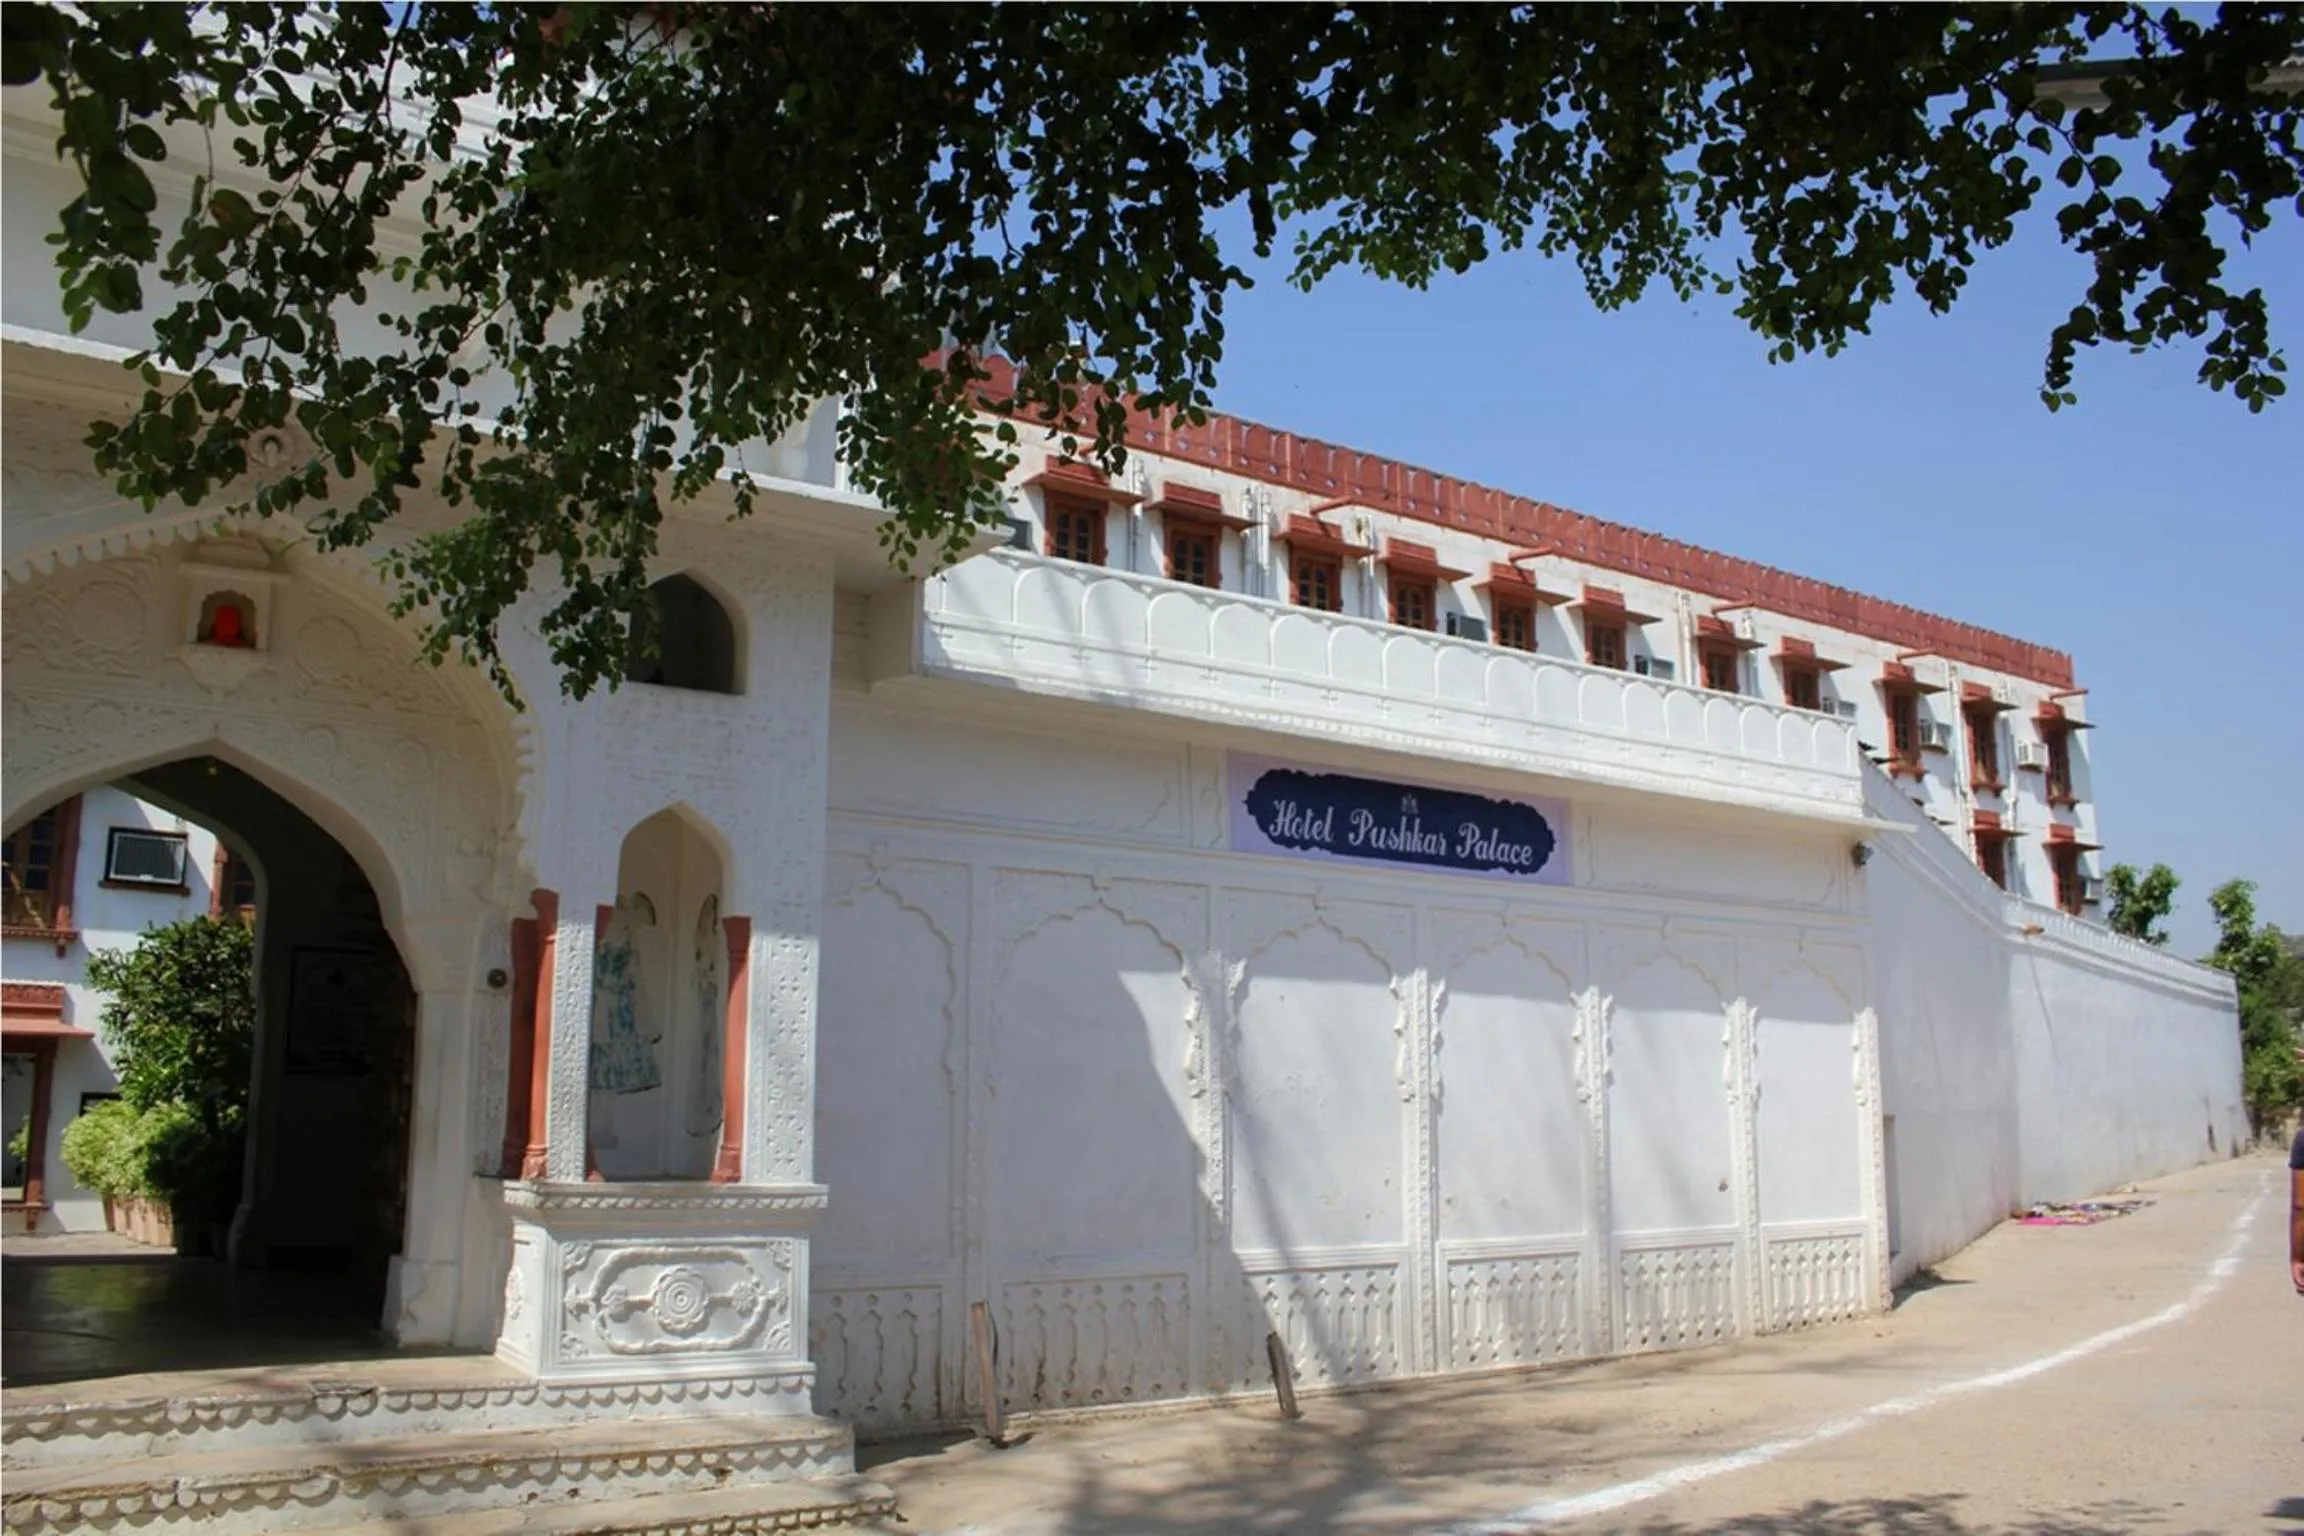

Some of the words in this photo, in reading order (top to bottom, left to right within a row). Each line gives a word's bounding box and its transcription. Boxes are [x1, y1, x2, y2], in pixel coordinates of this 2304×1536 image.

[1268, 799, 1334, 843] Hotel
[1349, 808, 1448, 856] Pushkar
[1456, 822, 1534, 866] Palace
